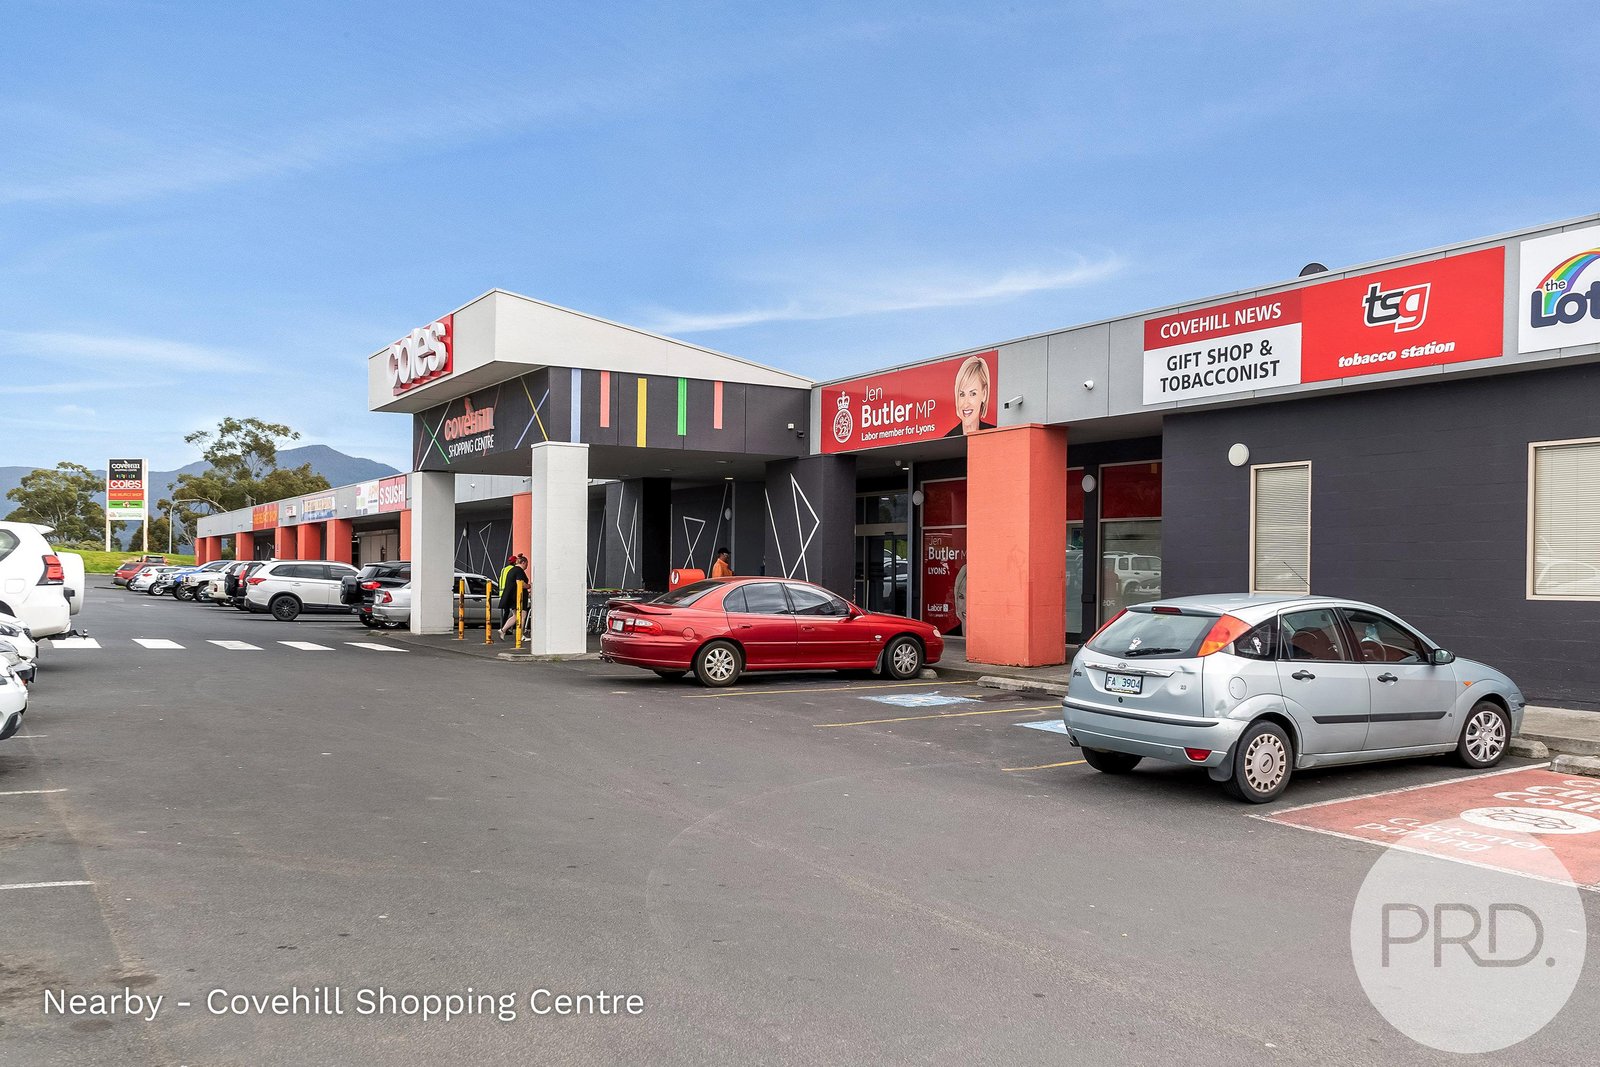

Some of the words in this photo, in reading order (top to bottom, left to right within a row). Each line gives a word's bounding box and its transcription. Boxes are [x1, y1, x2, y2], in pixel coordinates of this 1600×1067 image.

[1545, 280, 1566, 292] the
[1362, 282, 1431, 333] tsg
[1531, 281, 1600, 329] Lot
[1160, 312, 1230, 339] COVEHILL
[1235, 302, 1282, 326] NEWS
[386, 321, 448, 384] coles
[1167, 351, 1202, 371] GIFT
[1207, 342, 1253, 365] SHOP
[1259, 339, 1273, 356] &
[1338, 353, 1397, 368] tobacco
[1400, 341, 1456, 359] station
[1160, 359, 1280, 393] TOBACCONIST
[862, 385, 883, 403] Jen
[861, 399, 914, 428] Butler
[915, 399, 936, 420] MP
[861, 432, 879, 442] Labor
[879, 427, 905, 439] member
[905, 425, 915, 435] for
[915, 424, 936, 436] Lyons
[448, 439, 474, 459] SHOPPING
[474, 434, 495, 452] CENTRE
[110, 479, 142, 489] coles
[928, 535, 942, 546] Jen
[928, 546, 960, 561] Butler
[960, 549, 967, 560] M
[927, 566, 947, 575] LYONS
[927, 603, 943, 612] Labor
[1107, 676, 1116, 686] FA
[1121, 678, 1141, 689] 3904
[1352, 822, 1492, 852] parking
[1387, 817, 1555, 851] Customer
